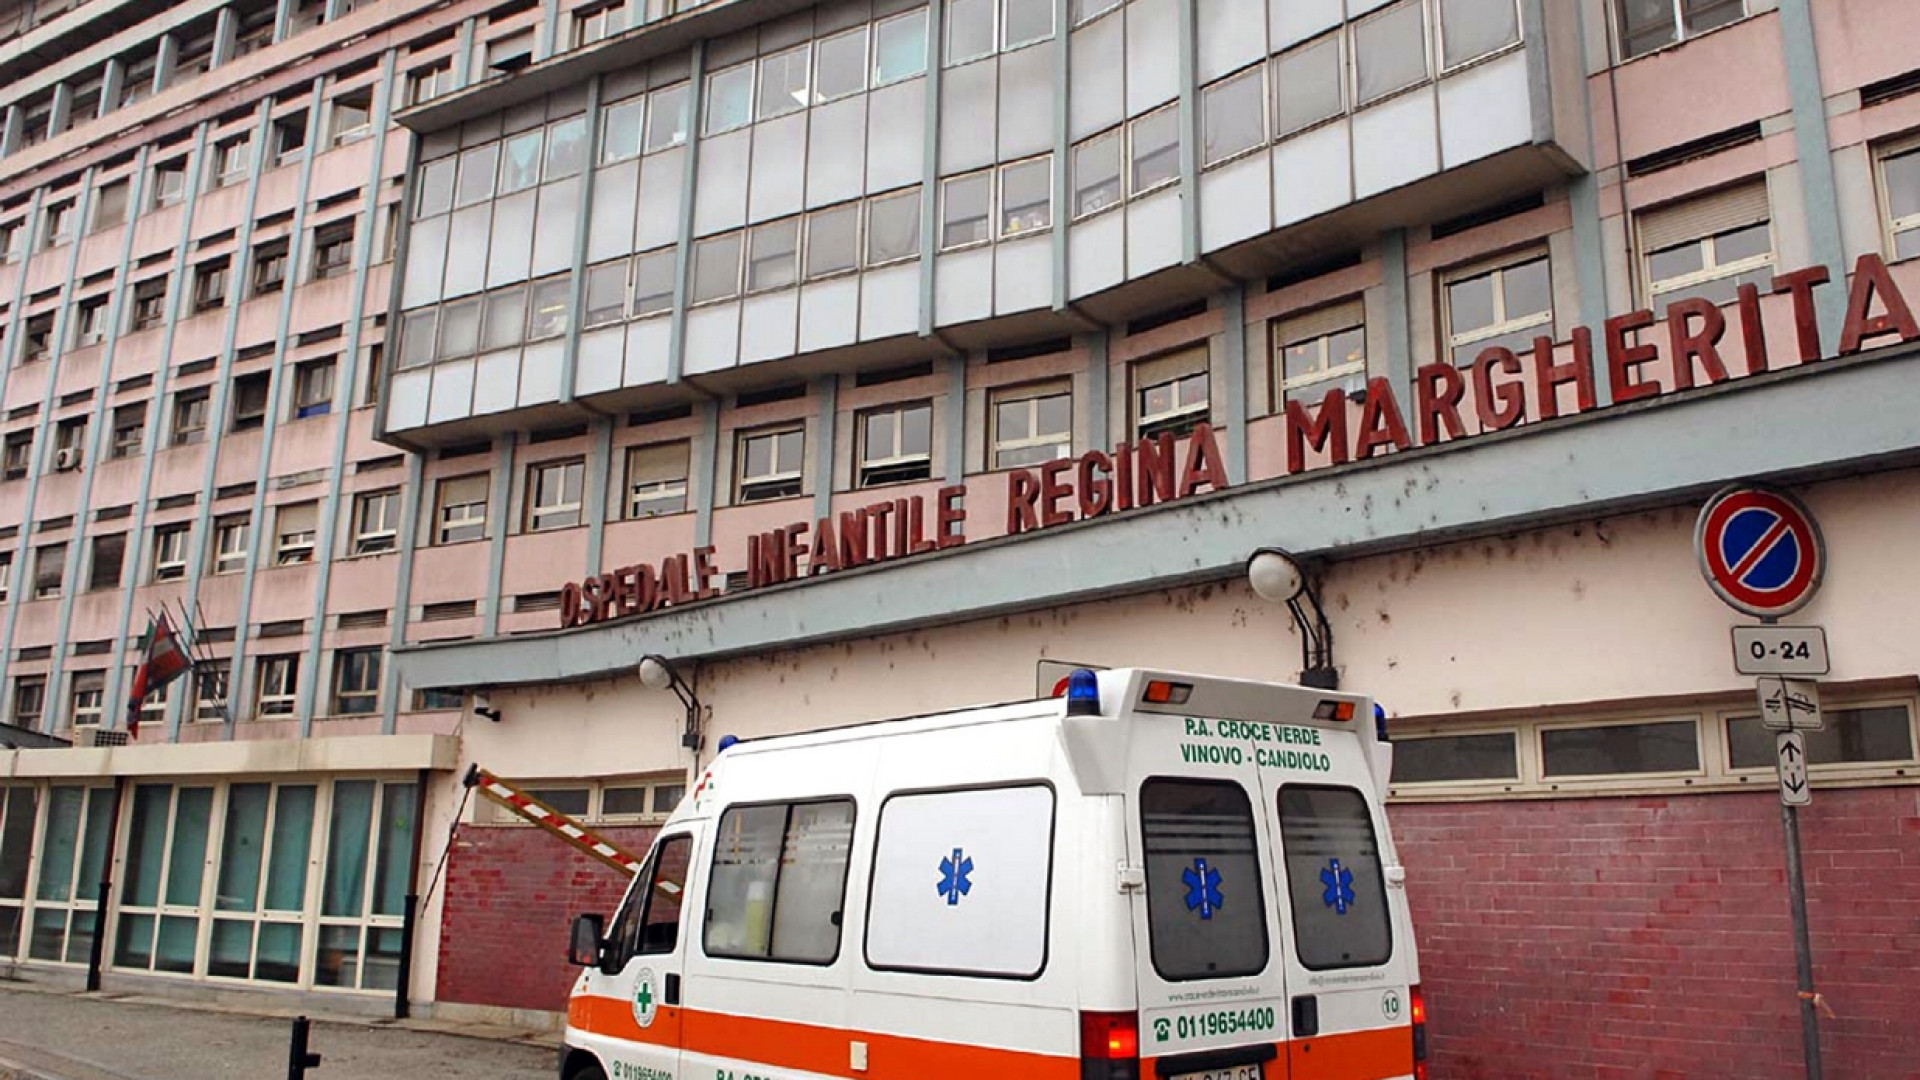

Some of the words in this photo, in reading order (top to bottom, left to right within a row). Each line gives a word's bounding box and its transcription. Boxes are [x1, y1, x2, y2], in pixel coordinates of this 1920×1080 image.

[559, 545, 720, 628] OSPEDALE
[746, 485, 967, 589] INFANTILE
[1006, 422, 1229, 536] REGINA
[1285, 252, 1919, 475] MARGHERITA
[1184, 717, 1214, 737] P.A.
[1217, 720, 1271, 742] CROCE
[1273, 725, 1321, 746] VERDE
[1181, 743, 1242, 766] VINOVO
[1256, 748, 1331, 772] CANDIOLO
[1384, 997, 1399, 1013] 10
[1177, 1006, 1275, 1039] 0119654400
